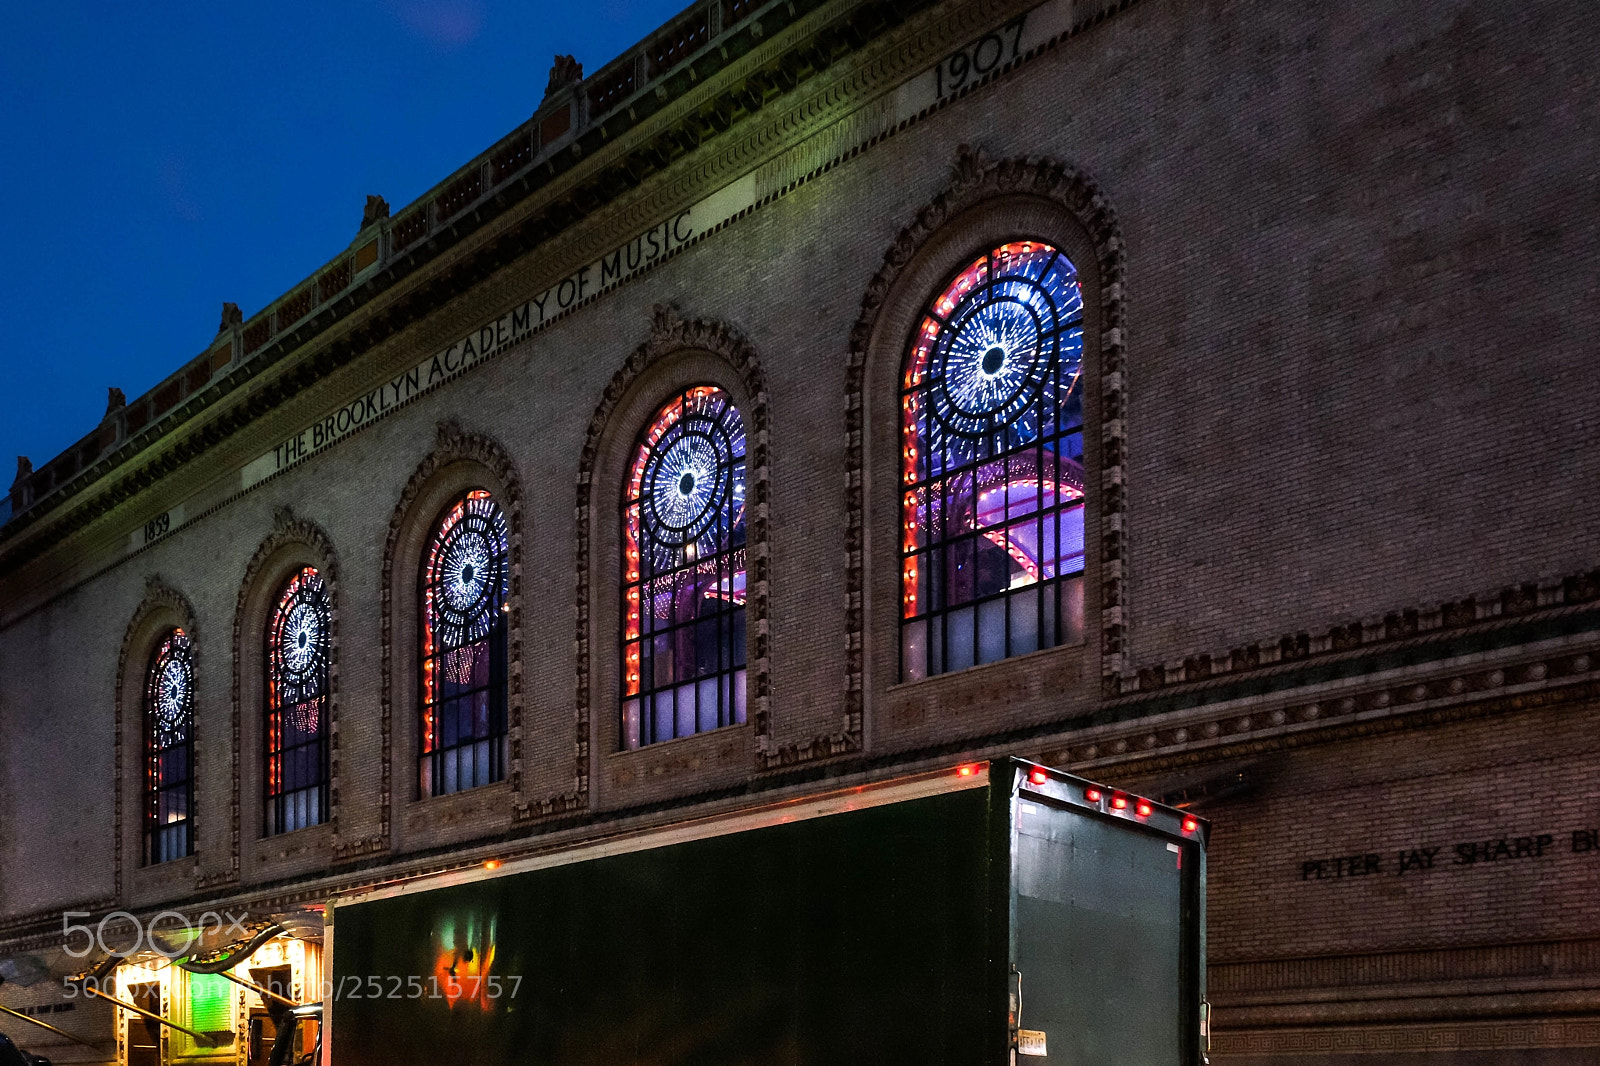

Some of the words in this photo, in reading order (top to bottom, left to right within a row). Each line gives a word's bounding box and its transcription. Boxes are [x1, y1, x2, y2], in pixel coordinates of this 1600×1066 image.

[935, 14, 1027, 99] 1907
[273, 436, 307, 469] THE
[313, 367, 420, 448] BROOKLYN
[427, 290, 550, 384] ACADEMY
[557, 265, 591, 308] OF
[600, 209, 693, 286] MUSIC
[143, 512, 171, 544] 1859
[1301, 853, 1381, 881] PETER
[1397, 846, 1442, 877] JAY
[1453, 833, 1555, 866] SHARP
